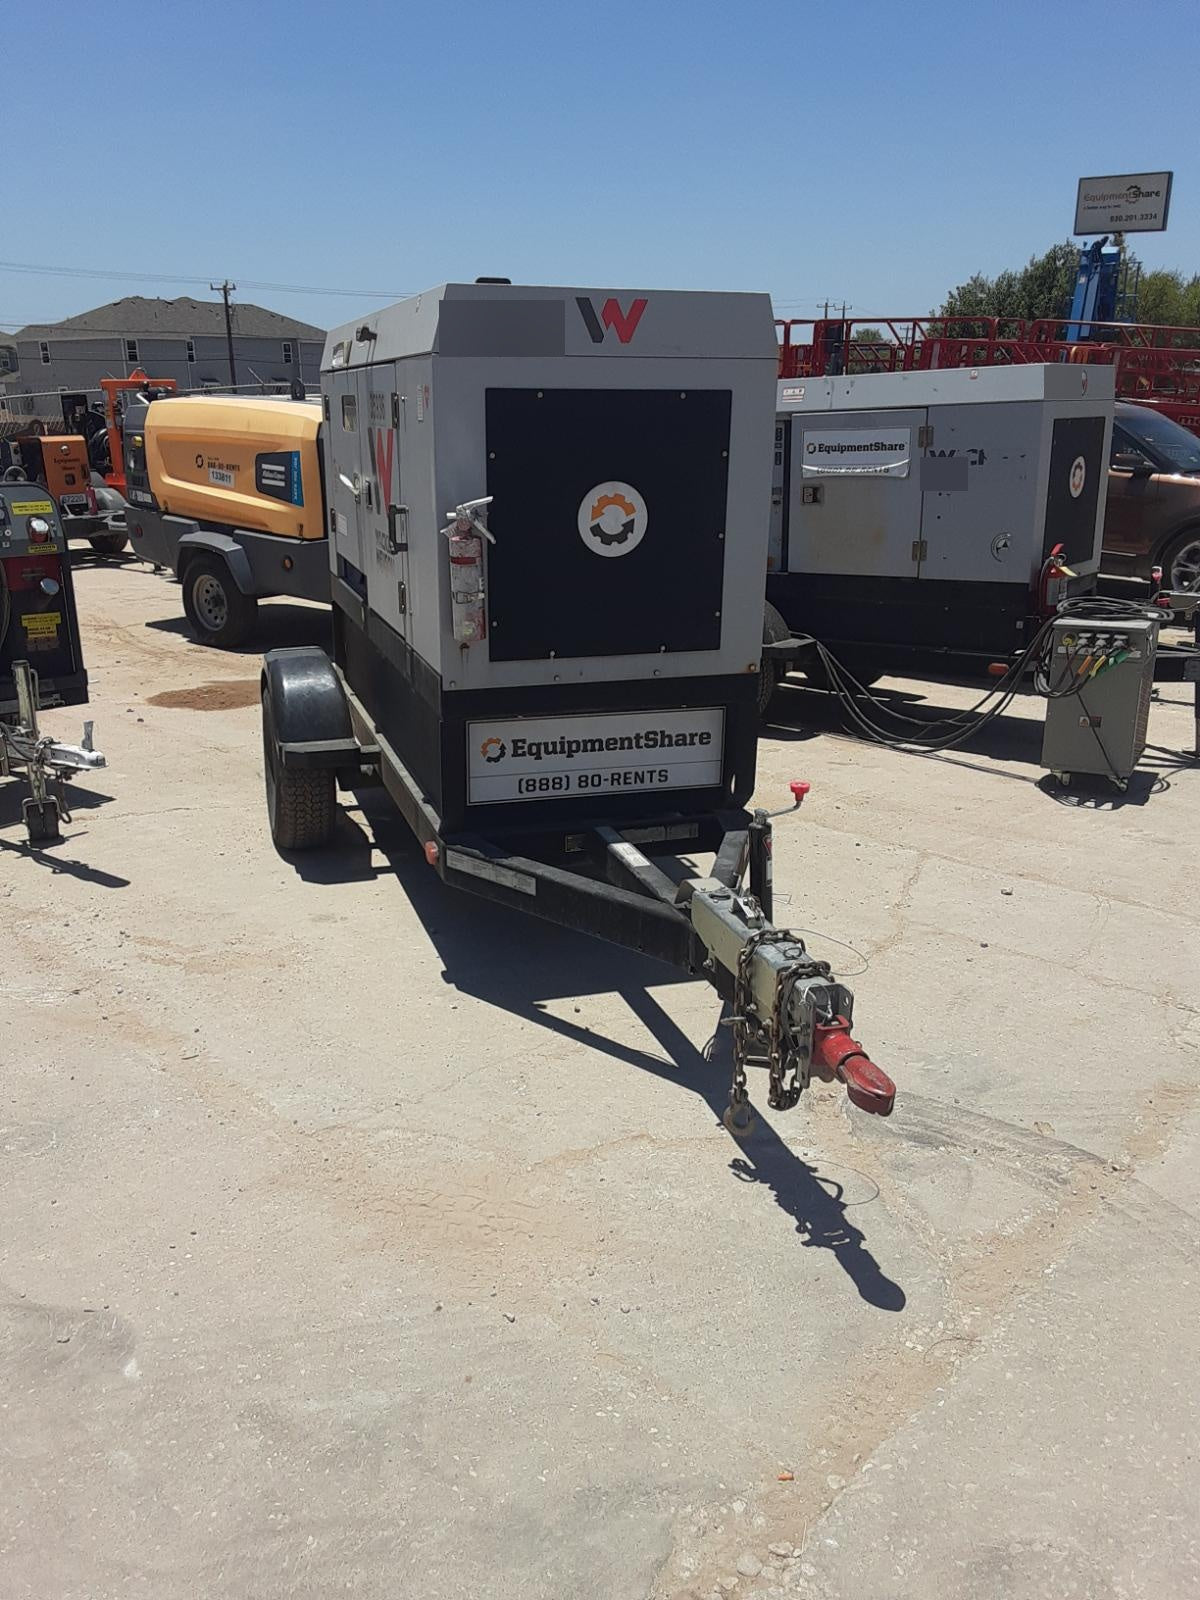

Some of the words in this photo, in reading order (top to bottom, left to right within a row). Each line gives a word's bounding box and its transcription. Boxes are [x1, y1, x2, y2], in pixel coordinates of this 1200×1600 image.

[818, 441, 906, 455] EquipmentShare
[511, 730, 712, 761] EquipmentShare
[518, 775, 571, 795] (888)
[577, 769, 670, 789] 80-RENTS
